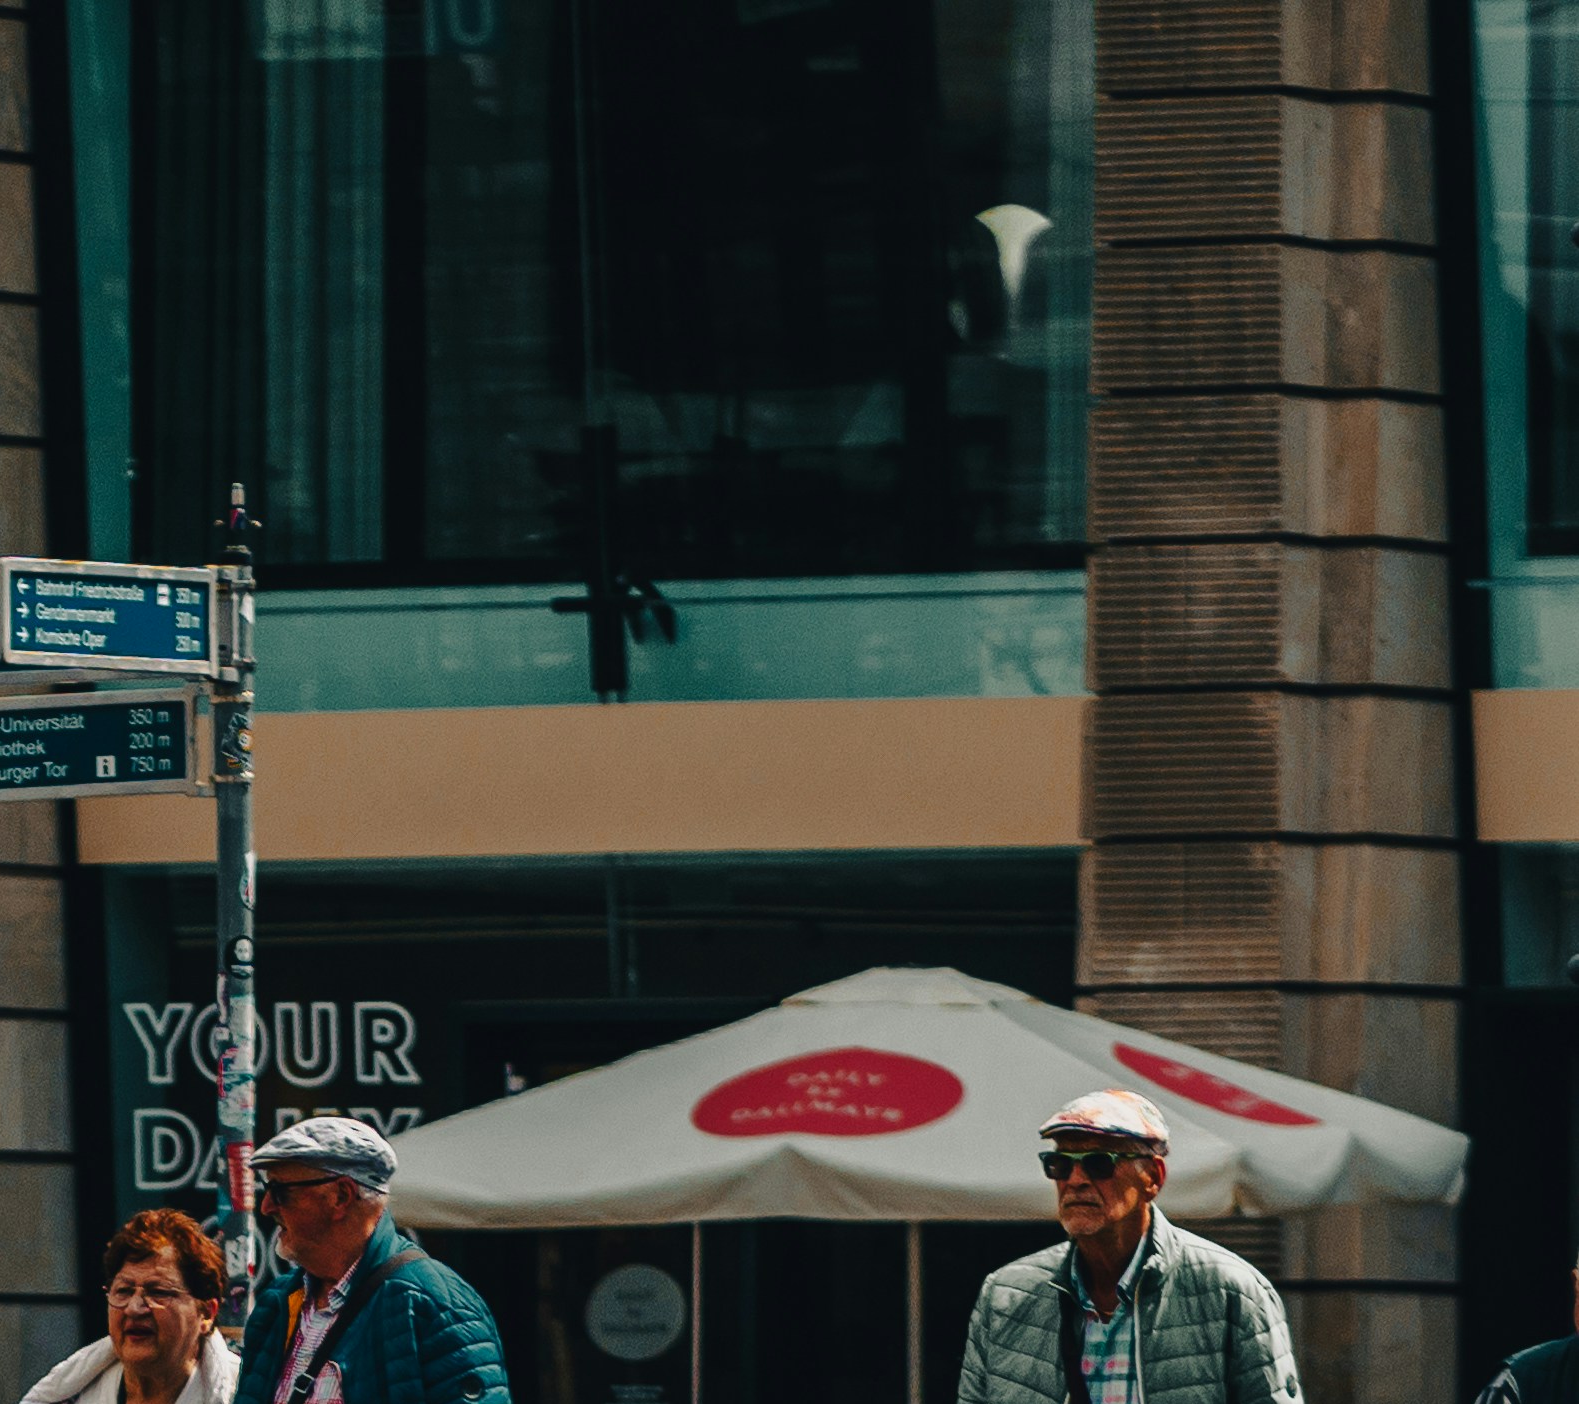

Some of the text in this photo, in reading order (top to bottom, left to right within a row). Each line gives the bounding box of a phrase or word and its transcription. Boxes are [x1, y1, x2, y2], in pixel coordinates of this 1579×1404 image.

[191, 591, 201, 605] m
[191, 615, 201, 629] m
[82, 629, 108, 651] Oper
[191, 640, 201, 653] m
[128, 708, 153, 725] 350
[157, 710, 170, 723] m
[129, 732, 154, 749] 200
[158, 734, 171, 748] m
[42, 761, 69, 778] Tor
[130, 756, 155, 773] 750
[158, 757, 172, 771] m
[122, 1001, 423, 1088] YOUR
